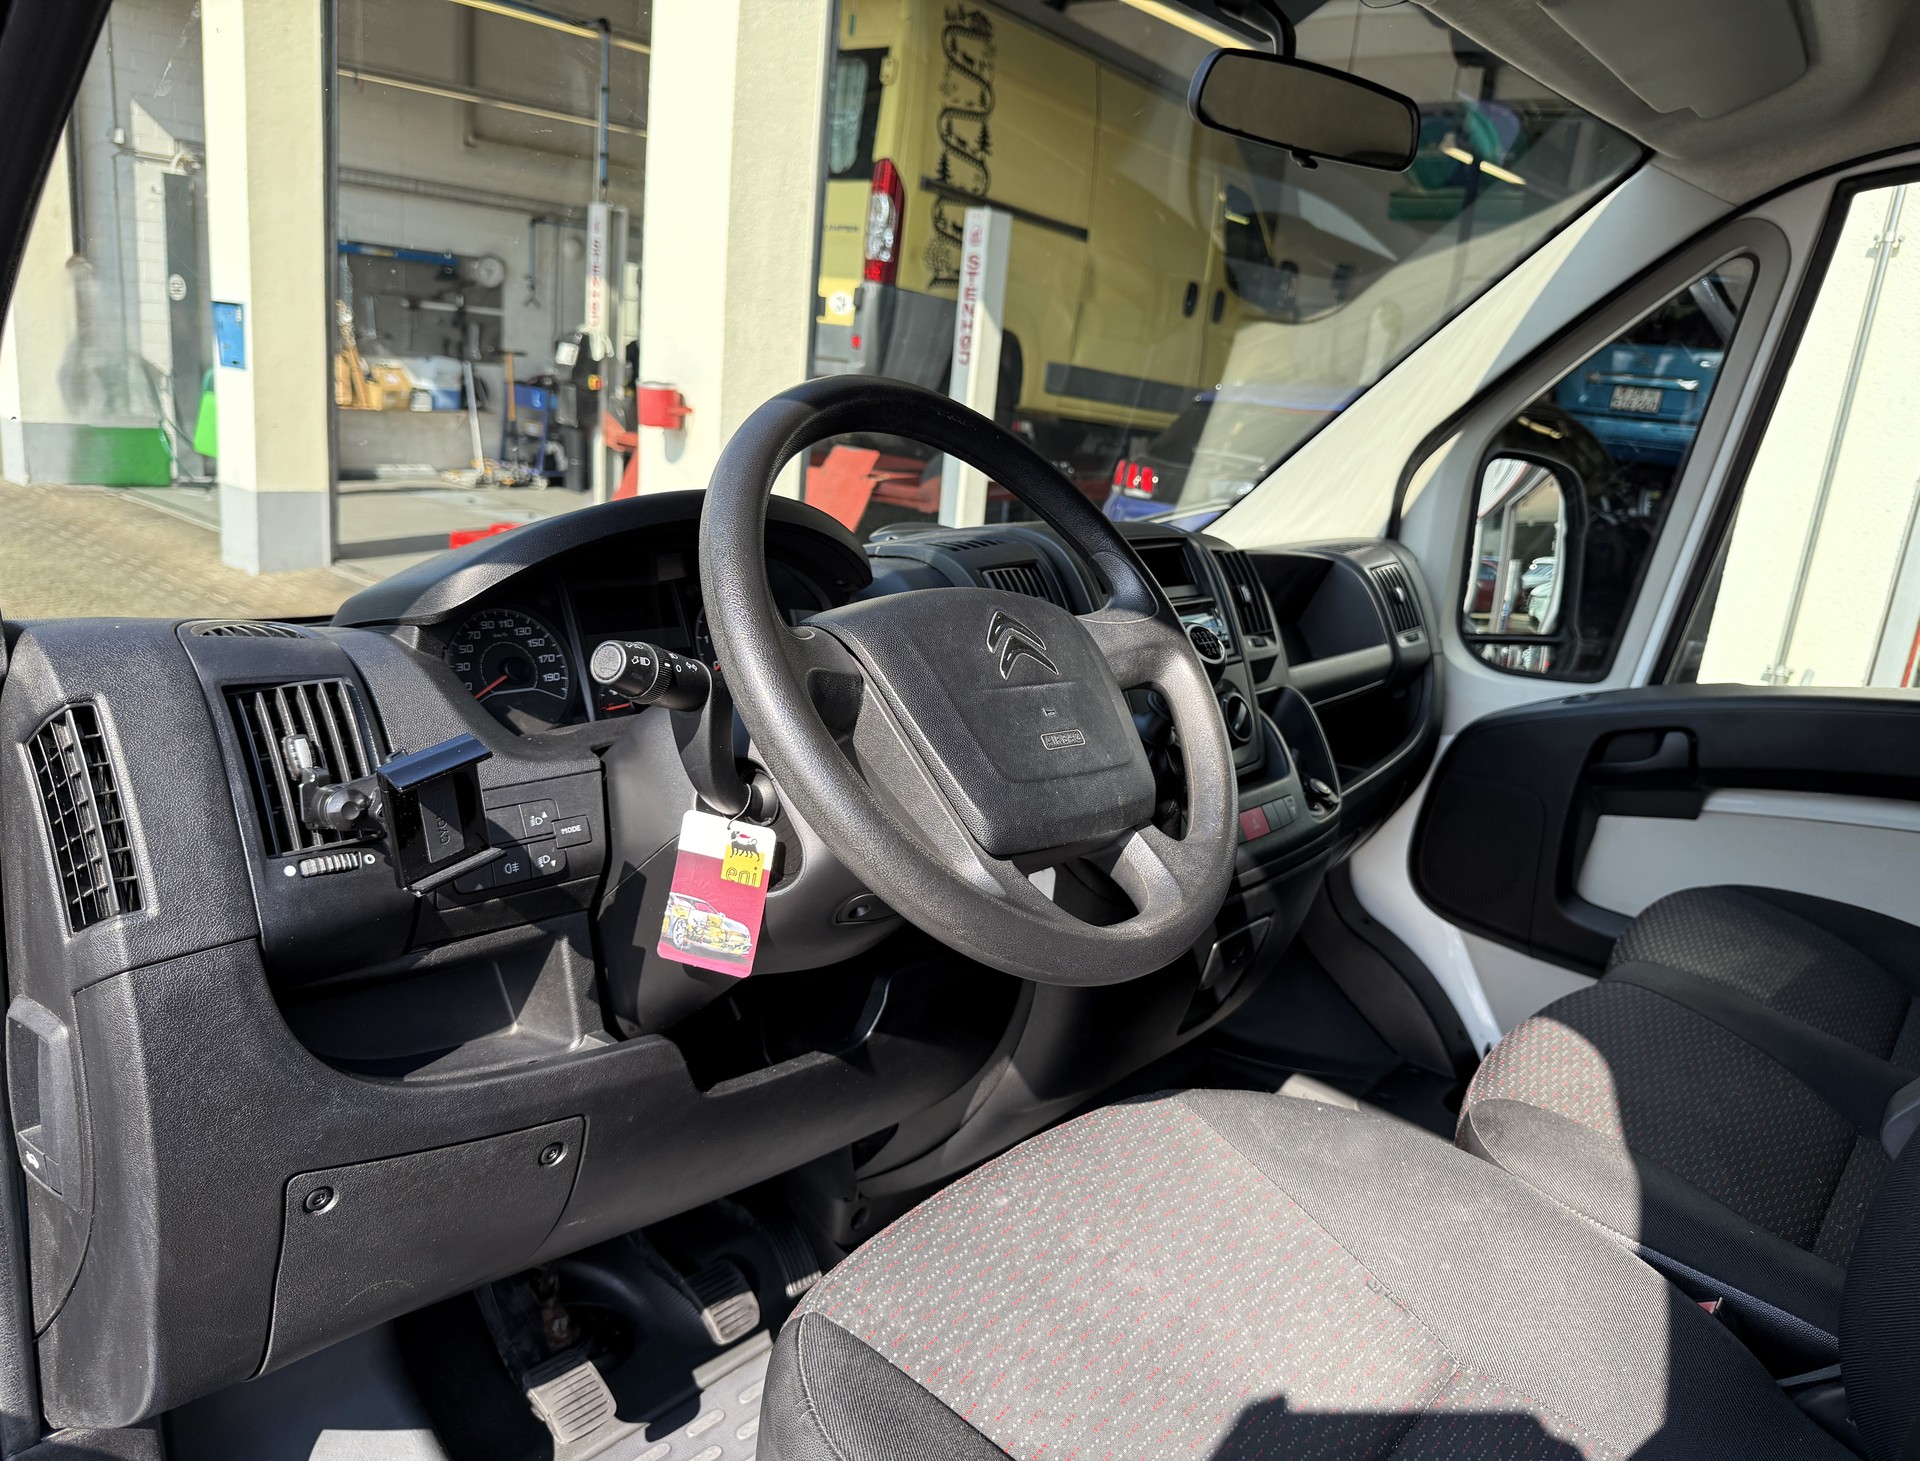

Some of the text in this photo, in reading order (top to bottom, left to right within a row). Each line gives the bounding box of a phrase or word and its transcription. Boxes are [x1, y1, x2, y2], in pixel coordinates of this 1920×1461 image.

[481, 620, 495, 629] 90
[499, 619, 514, 628] 110
[467, 631, 481, 640] 70
[514, 627, 532, 636] 130
[528, 638, 545, 647] 150
[459, 644, 474, 654] 50
[539, 654, 556, 663] 170
[456, 662, 471, 671] 30
[543, 673, 561, 682] 190
[560, 824, 582, 835] MODE
[725, 866, 758, 887] eni
